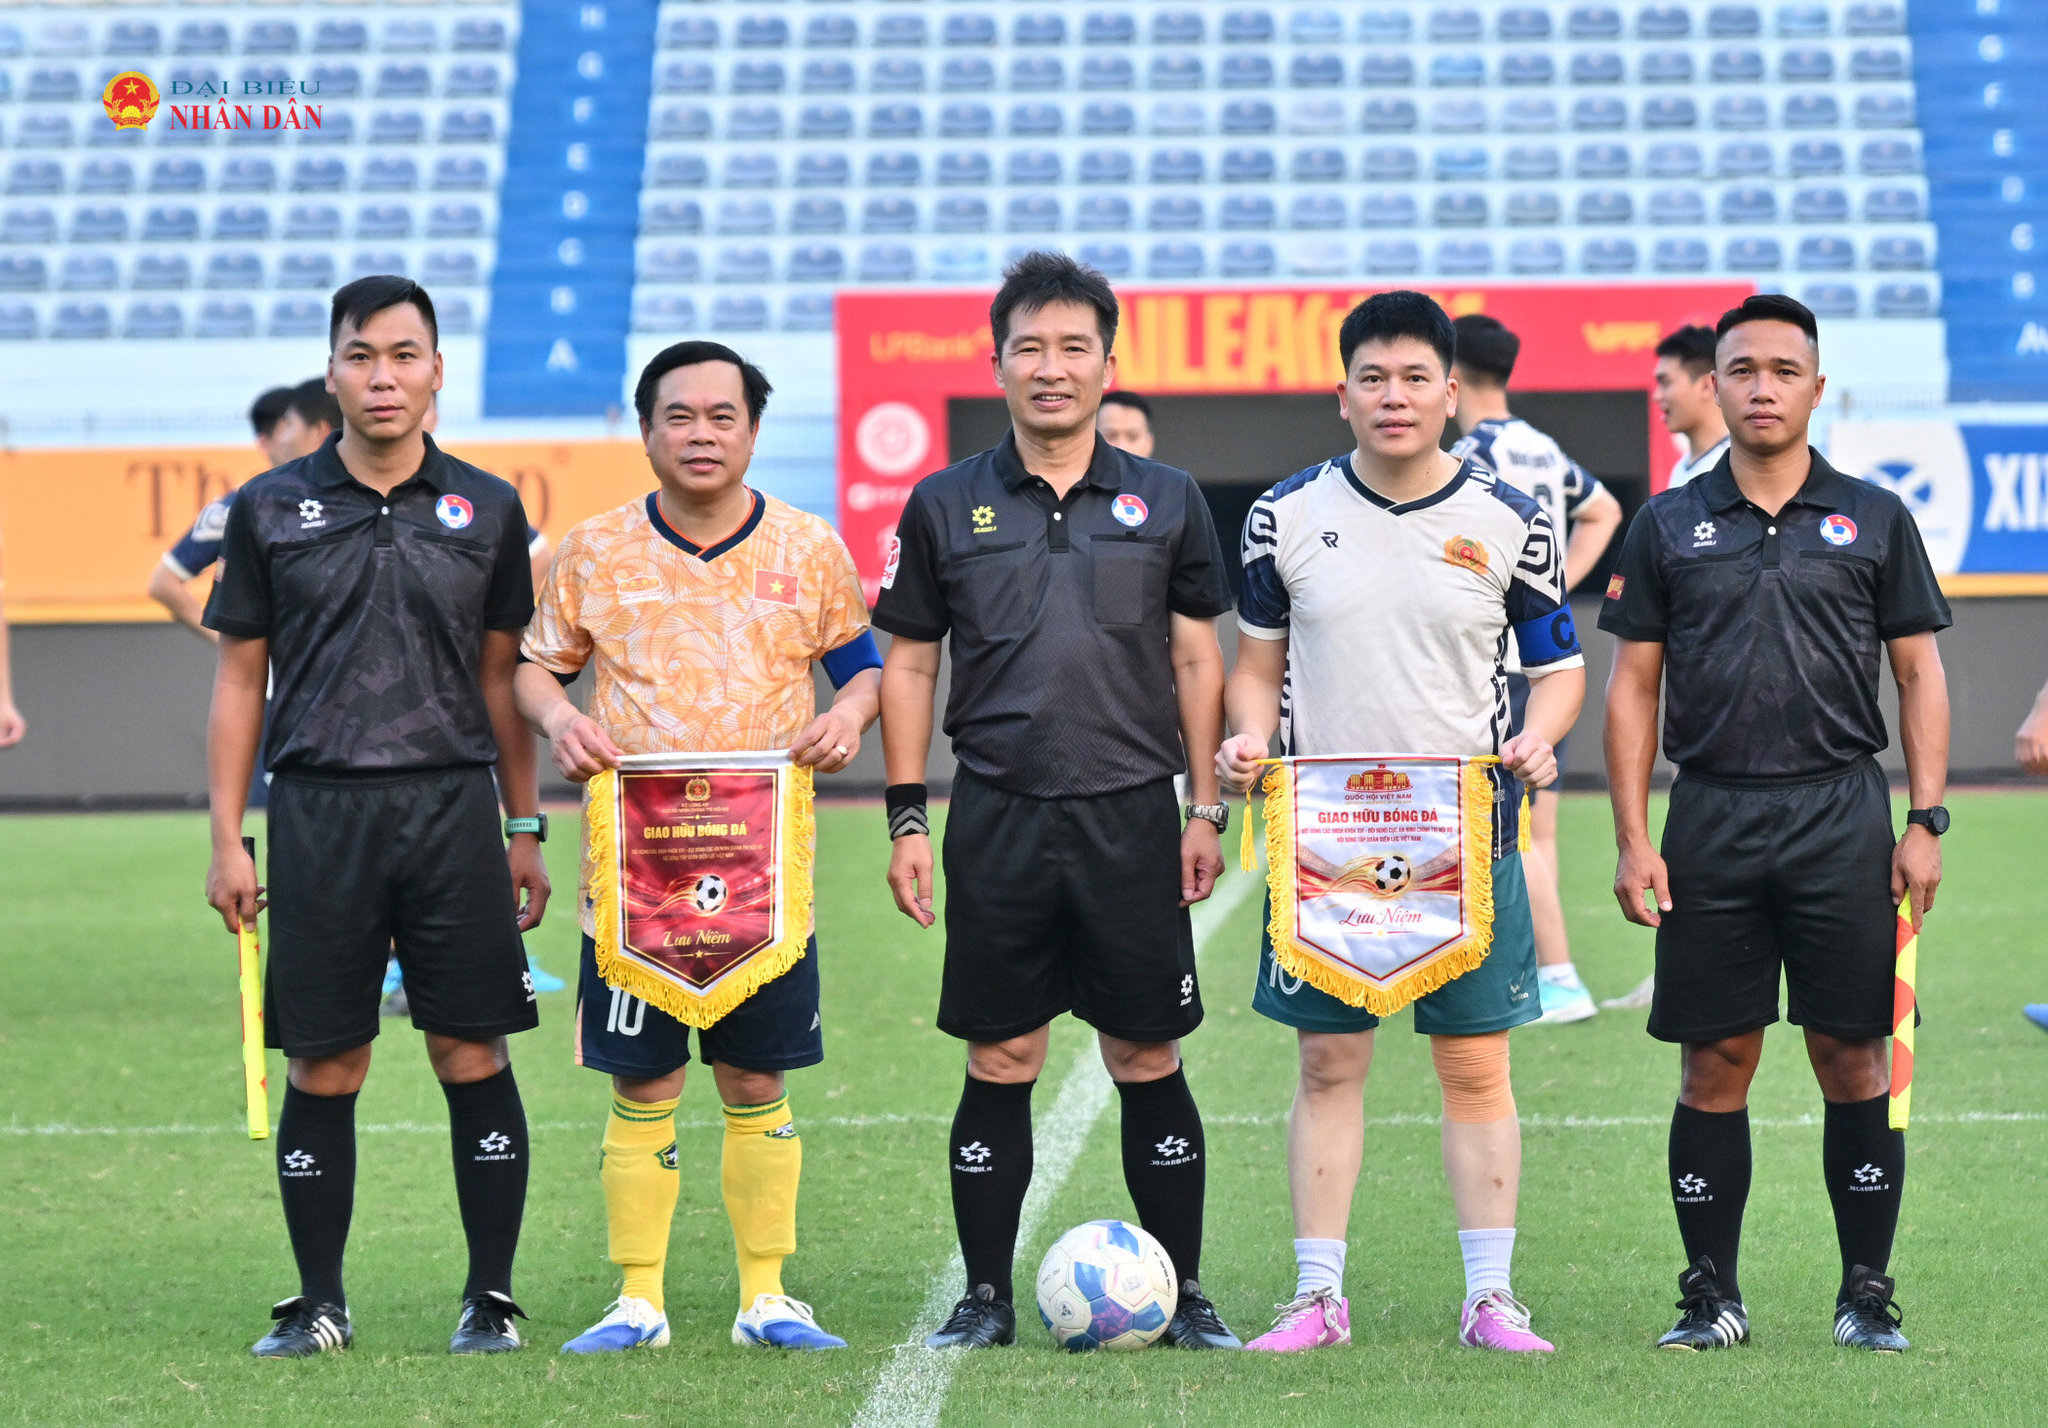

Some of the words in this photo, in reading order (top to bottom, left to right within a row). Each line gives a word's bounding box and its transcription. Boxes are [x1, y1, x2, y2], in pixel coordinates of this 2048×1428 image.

[1983, 452, 2048, 531] XI
[1551, 612, 1574, 650] C
[1365, 793, 1378, 801] HỘI
[1318, 811, 1349, 823] GIAO
[1353, 808, 1380, 823] HỮU
[1383, 807, 1418, 823] BÓNG
[1421, 807, 1438, 822] ĐÁ
[643, 826, 670, 839] GIAO
[672, 822, 697, 838] HỮU
[697, 822, 729, 837] BÓNG
[730, 821, 748, 836] ĐÁ
[1339, 907, 1376, 927] Lưu
[1377, 905, 1423, 926] Niệm
[663, 930, 692, 947] Lưu
[696, 929, 731, 948] Niệm
[606, 985, 646, 1037] 10
